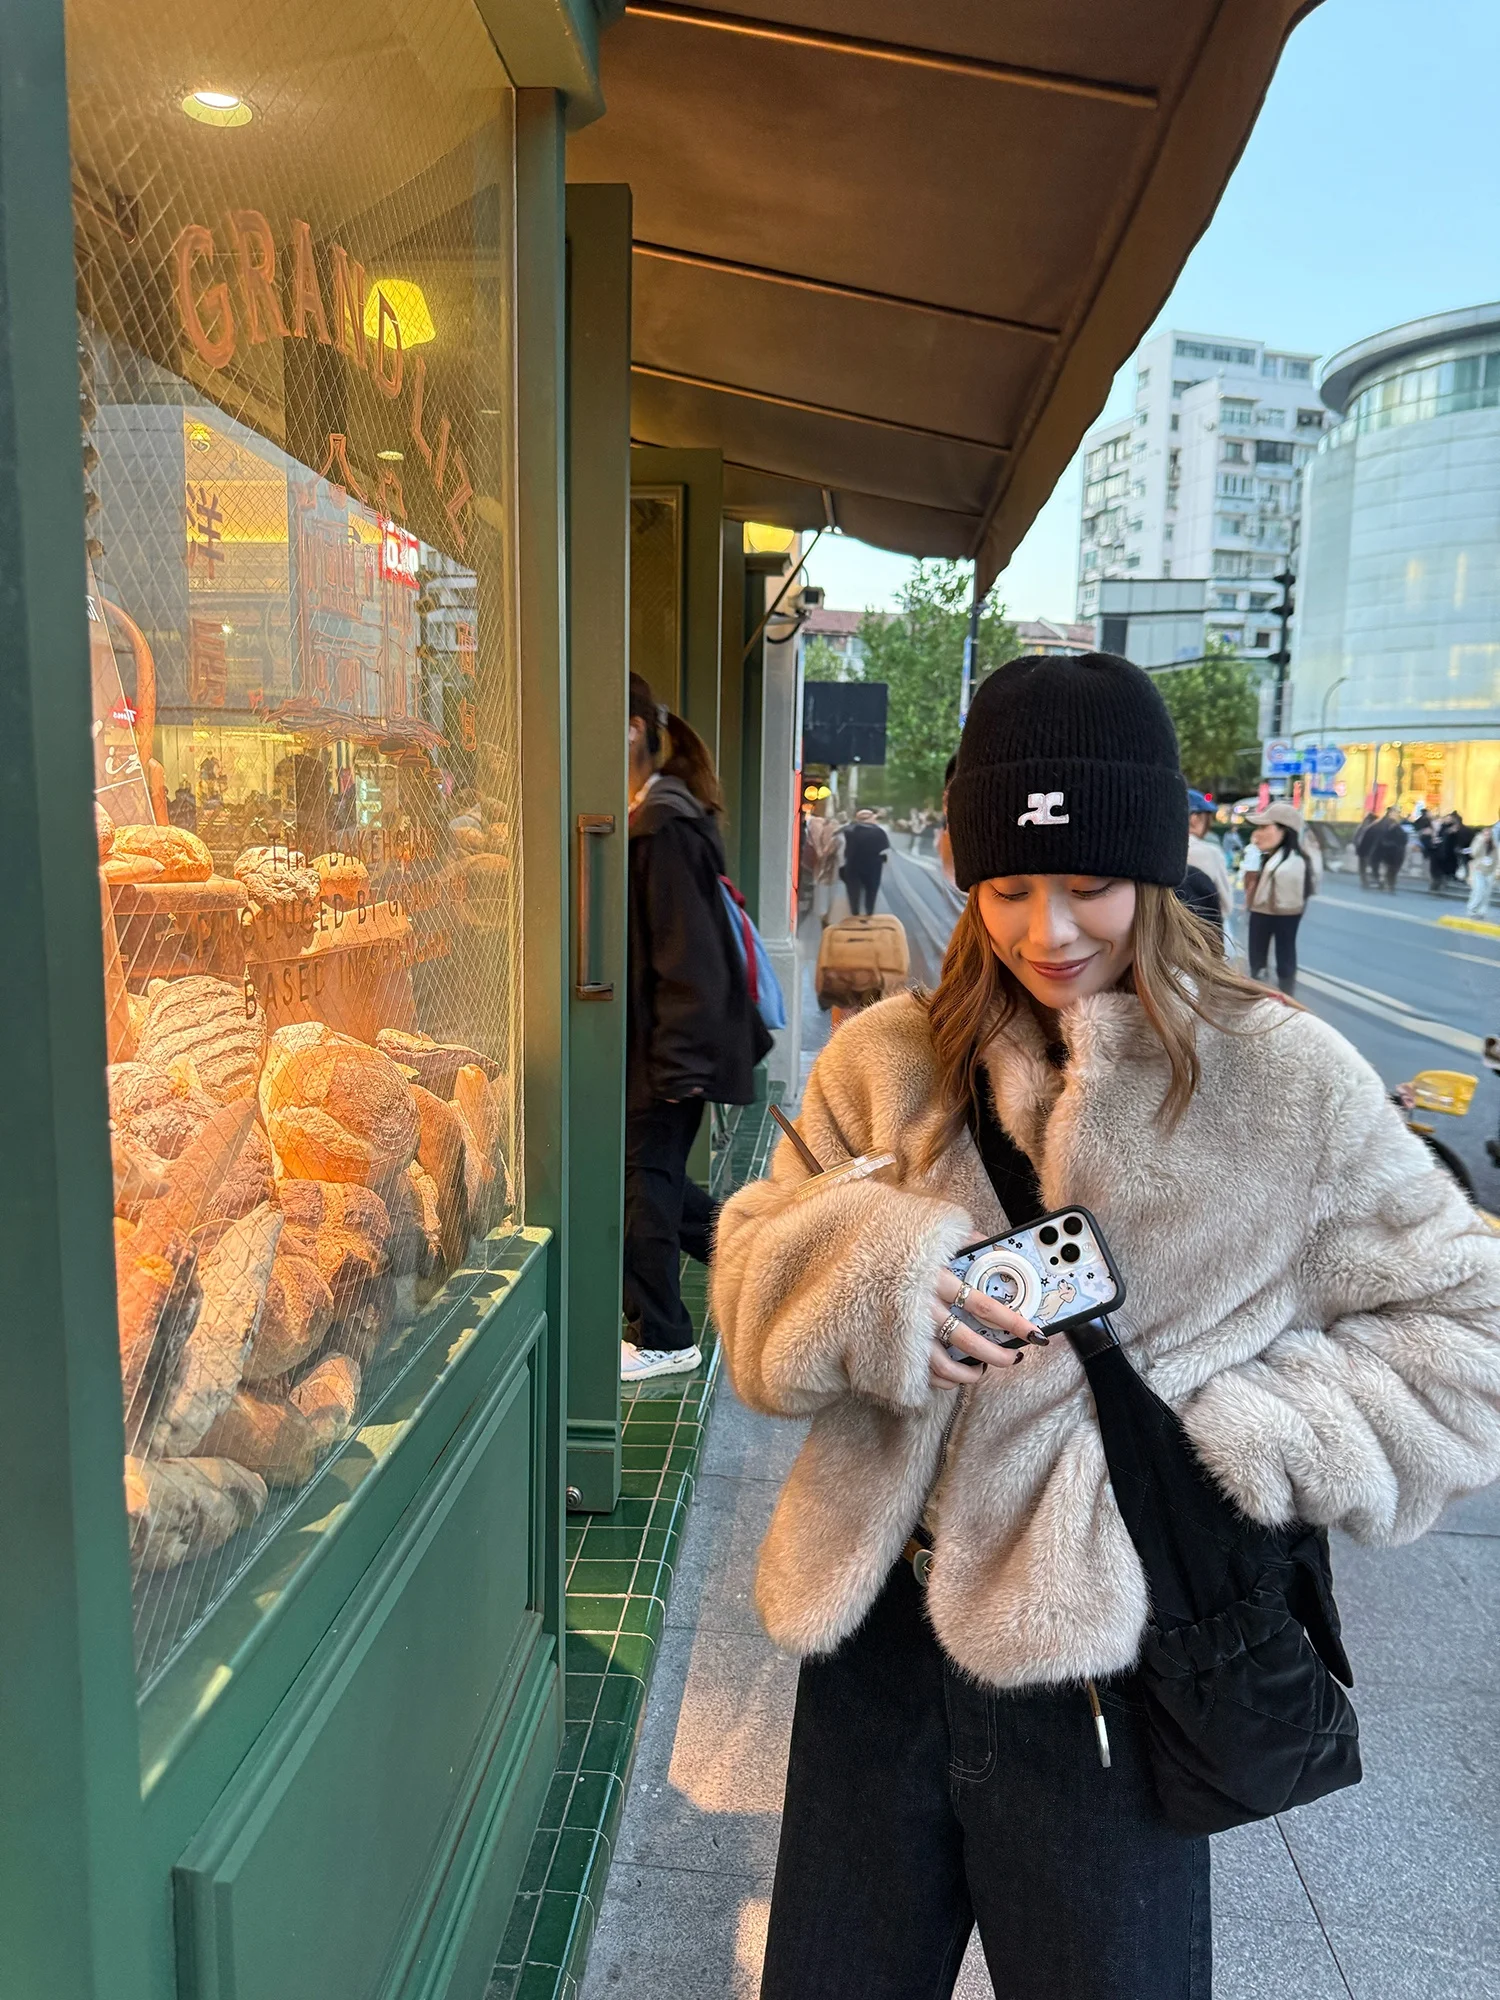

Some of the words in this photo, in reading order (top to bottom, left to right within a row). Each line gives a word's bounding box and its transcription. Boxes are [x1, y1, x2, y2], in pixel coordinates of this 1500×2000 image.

[179, 209, 404, 399] GRAND
[197, 893, 344, 959] PRODUCED
[358, 889, 379, 924] BY
[244, 960, 326, 1020] BASED
[340, 951, 359, 988] IN
